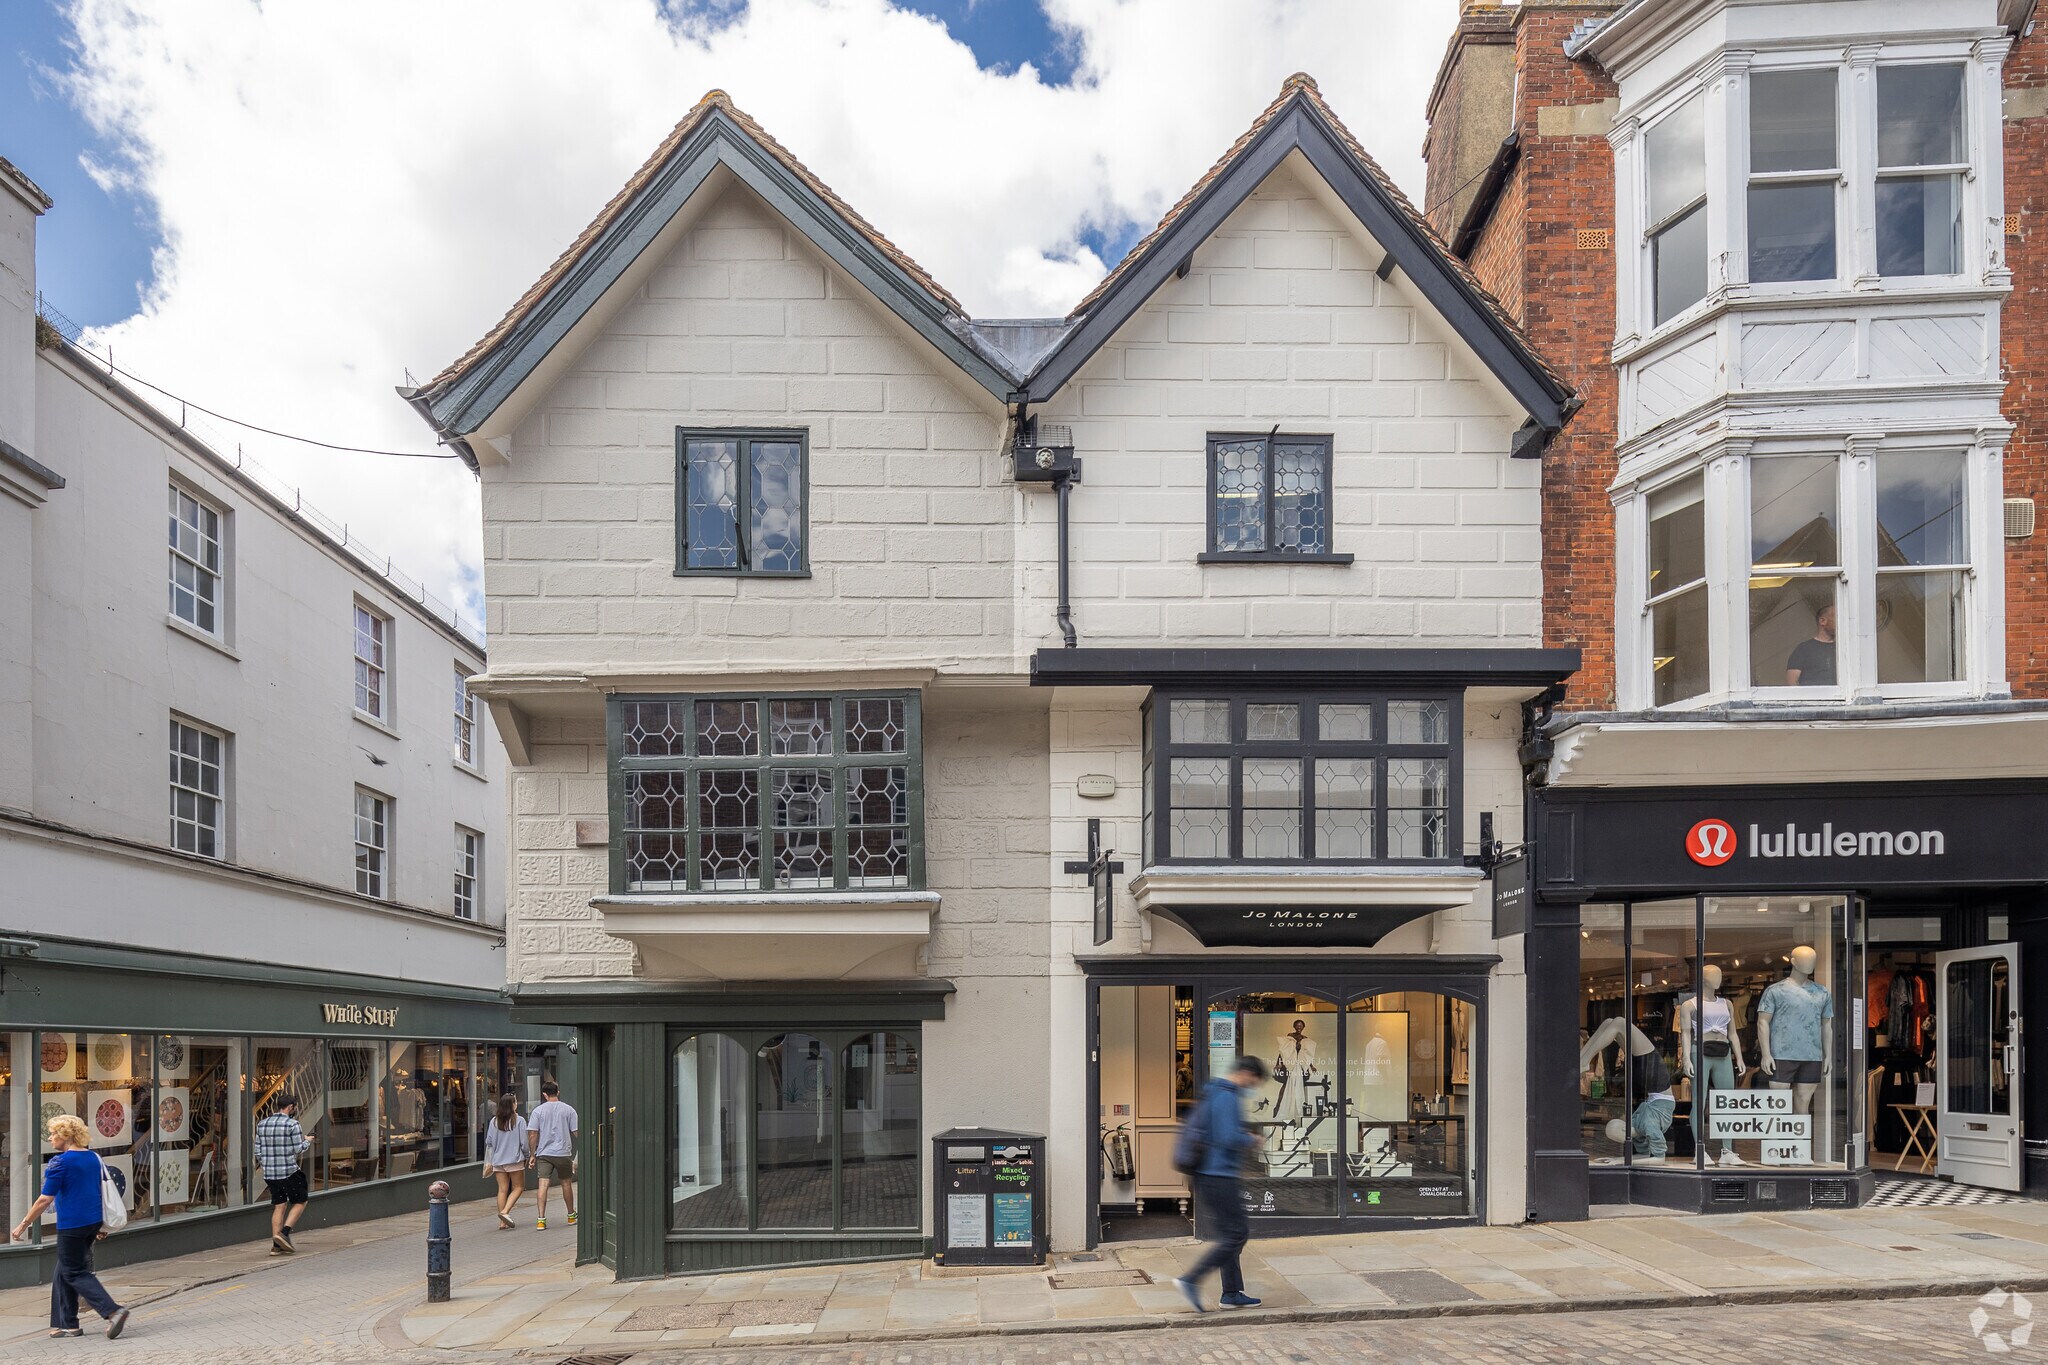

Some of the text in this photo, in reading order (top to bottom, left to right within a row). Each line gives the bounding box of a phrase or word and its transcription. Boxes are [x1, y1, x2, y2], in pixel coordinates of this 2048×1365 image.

[1749, 822, 1945, 858] lululemon
[1273, 911, 1359, 919] MALONE
[1278, 1057, 1304, 1066] House
[1317, 1057, 1326, 1066] Jo
[1328, 1057, 1358, 1065] Mne
[1360, 1056, 1391, 1065] London
[1715, 1094, 1787, 1109] Back to
[1716, 1117, 1805, 1136] work/ing
